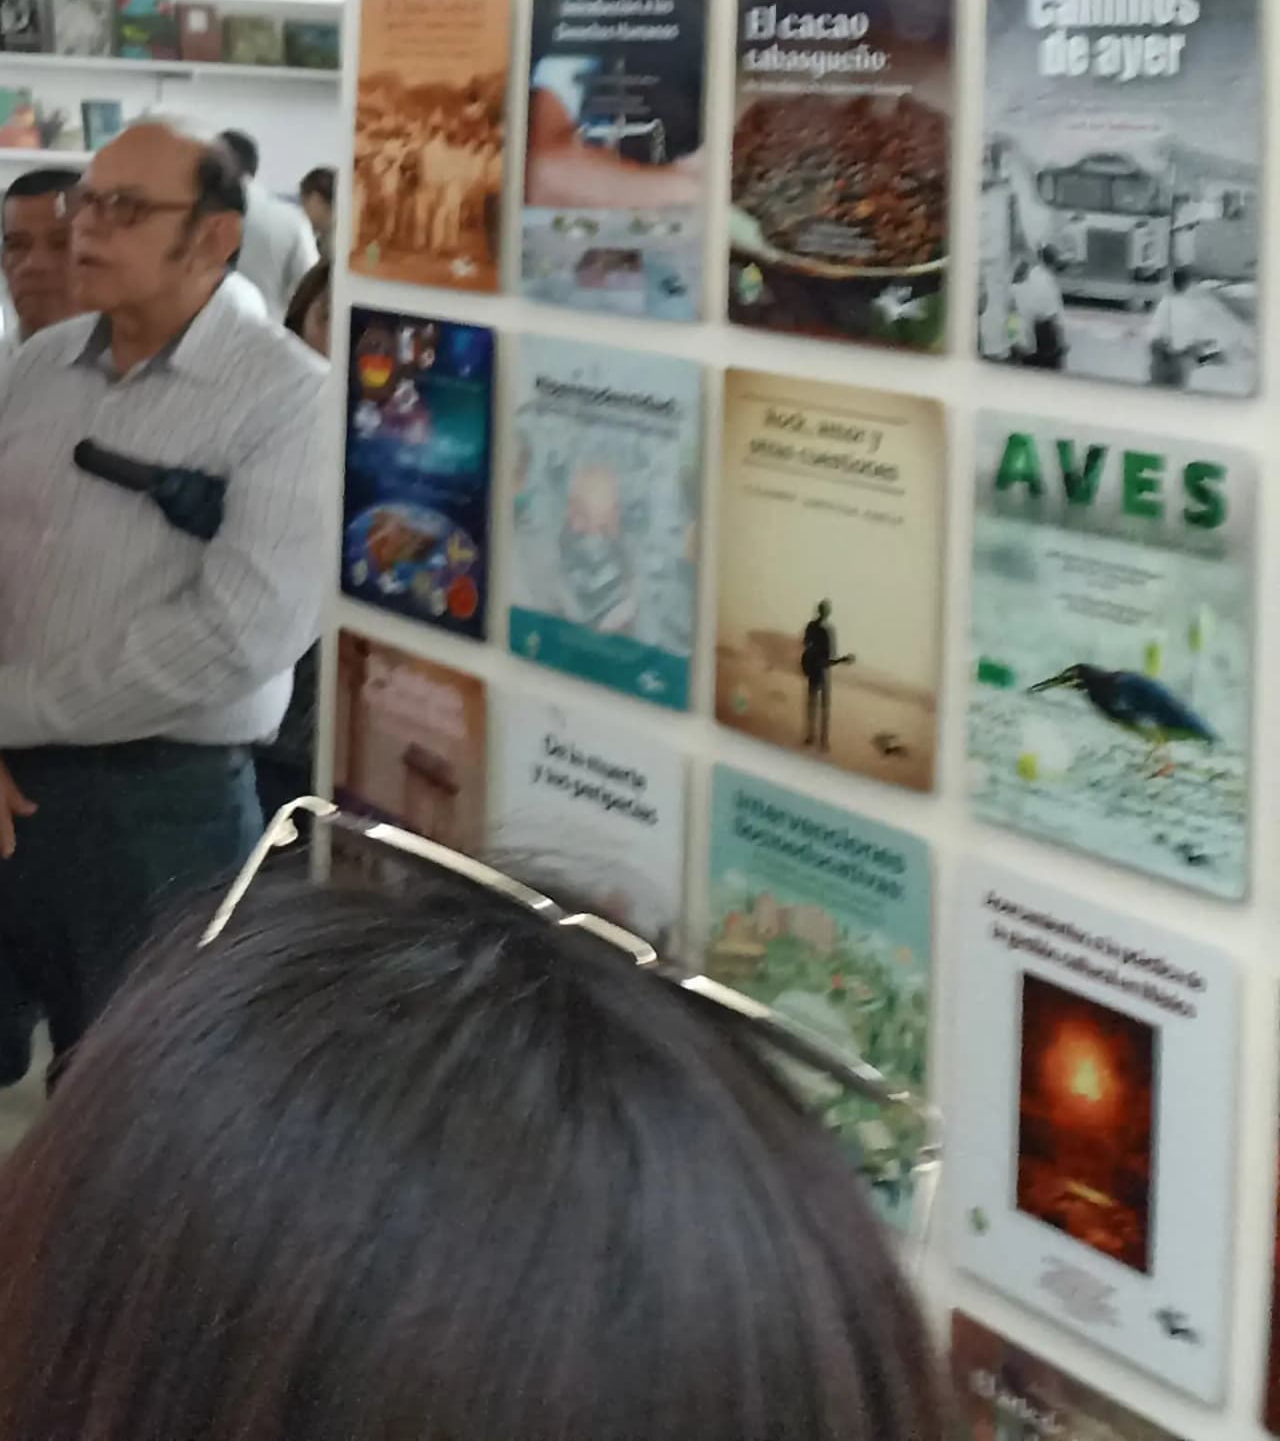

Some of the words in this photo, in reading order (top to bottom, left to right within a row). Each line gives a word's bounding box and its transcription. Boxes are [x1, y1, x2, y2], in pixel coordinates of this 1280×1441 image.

[743, 3, 776, 41] El
[775, 10, 870, 40] cacao
[1038, 30, 1088, 76] de
[1089, 33, 1187, 86] ayer
[994, 424, 1229, 536] AVES
